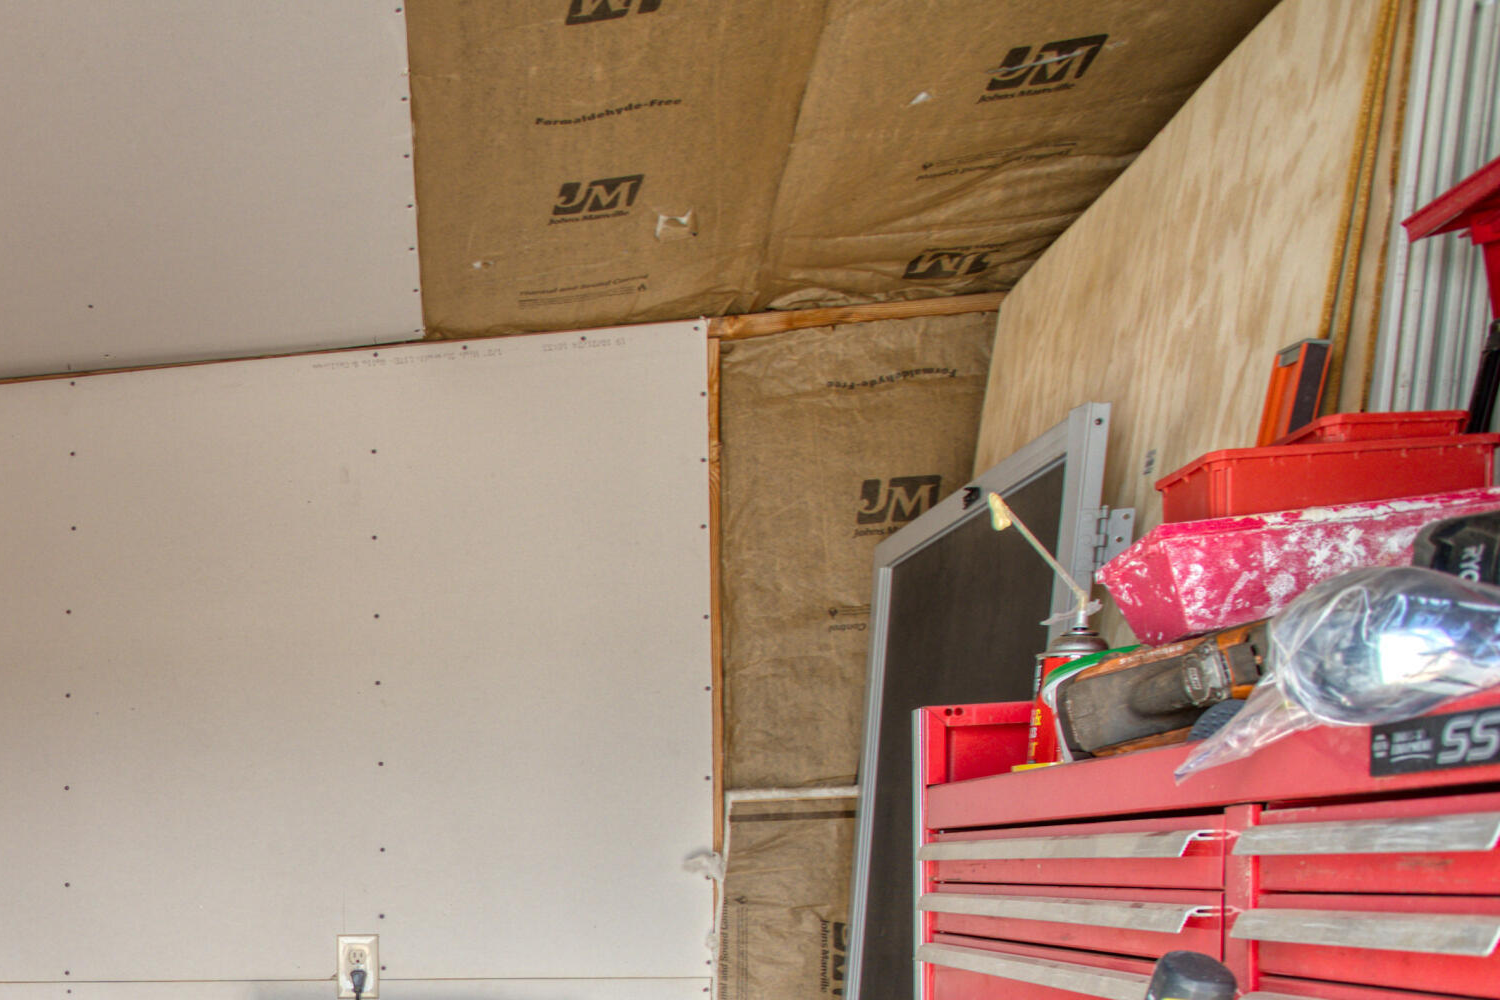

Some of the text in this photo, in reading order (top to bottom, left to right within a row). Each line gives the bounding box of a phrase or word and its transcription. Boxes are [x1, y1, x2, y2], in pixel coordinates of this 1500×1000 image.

[985, 33, 1108, 91] JM
[535, 99, 682, 125] Formaldehyde-Free
[552, 174, 644, 215] JM
[826, 367, 957, 390] Formaldehyde-Free
[856, 475, 942, 525] JM
[852, 526, 885, 539] Johns
[1459, 543, 1486, 582] RYO
[828, 622, 867, 633] Control
[820, 919, 830, 994] Johns Manville
